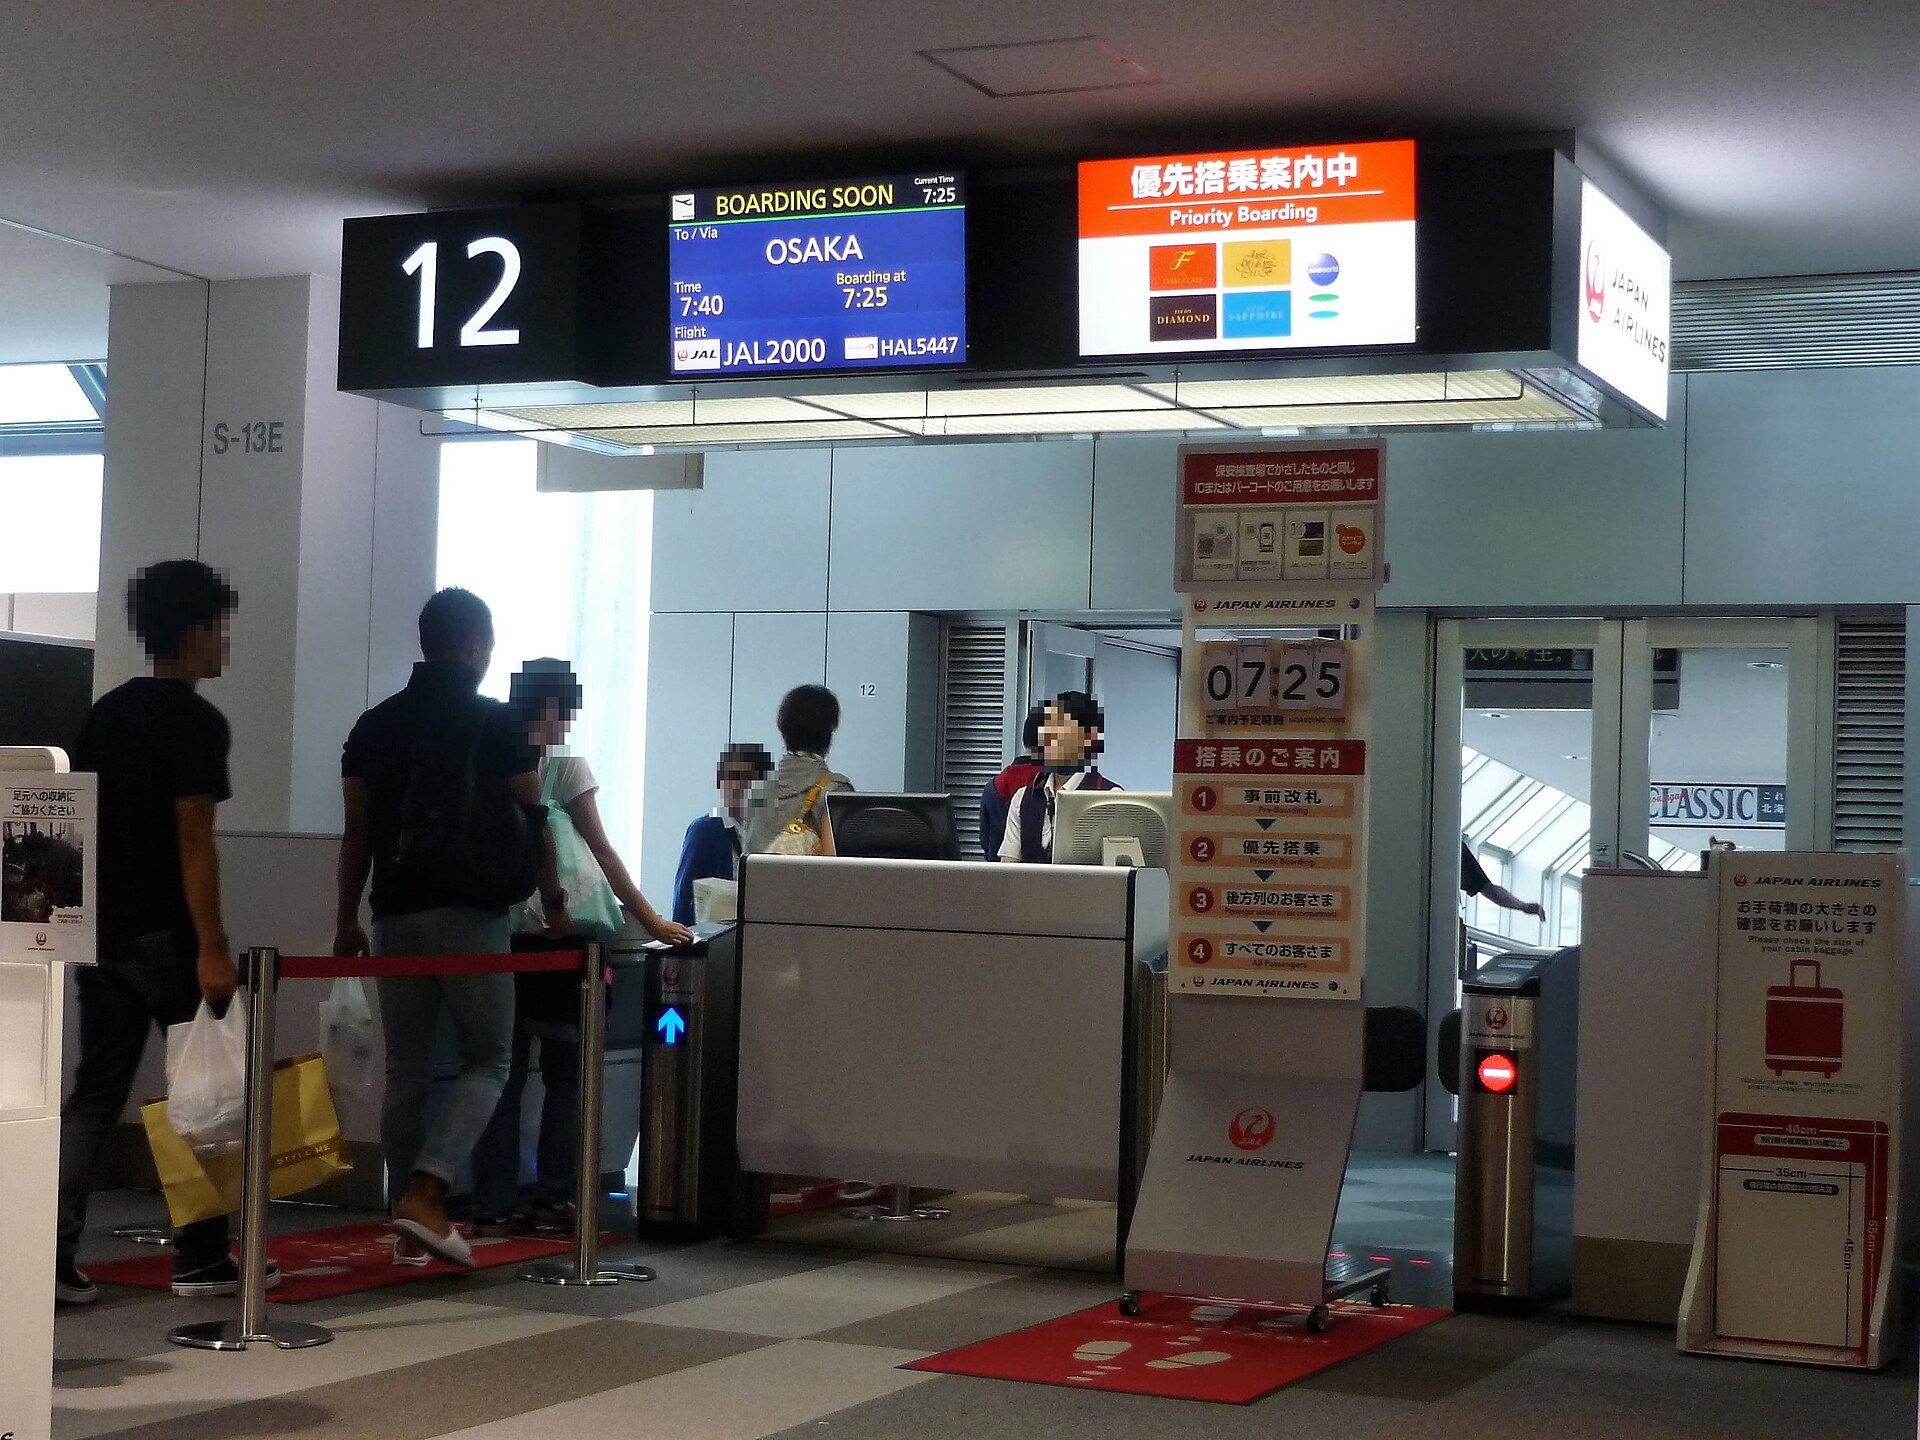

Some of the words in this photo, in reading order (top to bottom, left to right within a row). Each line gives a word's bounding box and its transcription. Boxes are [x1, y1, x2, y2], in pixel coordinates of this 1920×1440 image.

[914, 176, 938, 186] Current
[939, 175, 955, 184] Time
[1131, 152, 1357, 199] 優先搭乗案内中
[716, 188, 826, 216] BOARDING
[832, 184, 894, 208] SOON
[923, 187, 956, 205] 7:25
[1170, 206, 1232, 228] Priority
[1238, 203, 1318, 223] Boarding
[674, 228, 690, 241] To
[699, 225, 718, 239] Via
[766, 235, 864, 265] OSAKA
[836, 272, 890, 285] Boarding
[894, 270, 906, 282] at
[401, 236, 522, 349] 12
[674, 281, 702, 294] Time
[1612, 269, 1648, 312] JAPAN
[680, 295, 724, 316] 7:40
[843, 287, 888, 309] 7:25
[1157, 314, 1210, 325] DIAMOND
[1228, 311, 1285, 321] SAPPHIRE
[675, 325, 706, 339] Flight
[1613, 307, 1666, 363] AIRLINES
[689, 349, 718, 360] JAL
[723, 338, 826, 366] JAL2000
[881, 336, 959, 357] HAL5447
[213, 421, 284, 454] S-13E
[1213, 600, 1261, 610] JAPAN
[1264, 599, 1336, 609] AIRLINES
[1207, 661, 1341, 701] 07:25
[861, 685, 875, 695] 12
[1205, 714, 1284, 726] ご案内予定時刻
[1196, 746, 1340, 769] 搭乗のご案内
[13, 790, 75, 802] 足元への収納に
[1198, 792, 1207, 807] 1
[1244, 789, 1321, 805] 事前改札
[12, 804, 75, 816] ご協力ください
[1258, 806, 1309, 815] Pre-Boarding
[1197, 842, 1208, 857] 2
[1243, 840, 1320, 856] 優先搭乗
[1250, 857, 1278, 867] Priority
[1279, 857, 1315, 867] Boarding
[1753, 876, 1804, 886] JAPAN
[1807, 877, 1882, 888] AIRLINES
[1196, 893, 1207, 908] 3
[1226, 891, 1333, 907] 後方列のお客さま
[1737, 900, 1877, 917] お手荷物の大きさの
[1737, 917, 1877, 934] 確認をお願いします
[1748, 935, 1780, 943] Please
[1783, 937, 1810, 945] check
[1814, 937, 1830, 945] the
[1833, 938, 1852, 946] size
[1855, 938, 1865, 946] of
[1193, 943, 1204, 959] 4
[1225, 942, 1332, 959] すべてのお客さま
[1761, 945, 1782, 954] your
[1785, 945, 1811, 953] cabin
[1814, 946, 1854, 955] baggage
[1252, 959, 1264, 967] All
[1266, 960, 1307, 969] Passengers
[1209, 977, 1254, 987] JAPAN
[1255, 978, 1320, 990] AIRLINES
[1785, 1124, 1817, 1135] 40cm
[315, 1143, 330, 1154] ME
[1186, 1154, 1233, 1165] JAPAN
[1235, 1158, 1305, 1169] AIRLINES
[1775, 1167, 1807, 1178] 35cm
[1868, 1219, 1879, 1251] 55cm
[1843, 1237, 1854, 1270] 45cm
